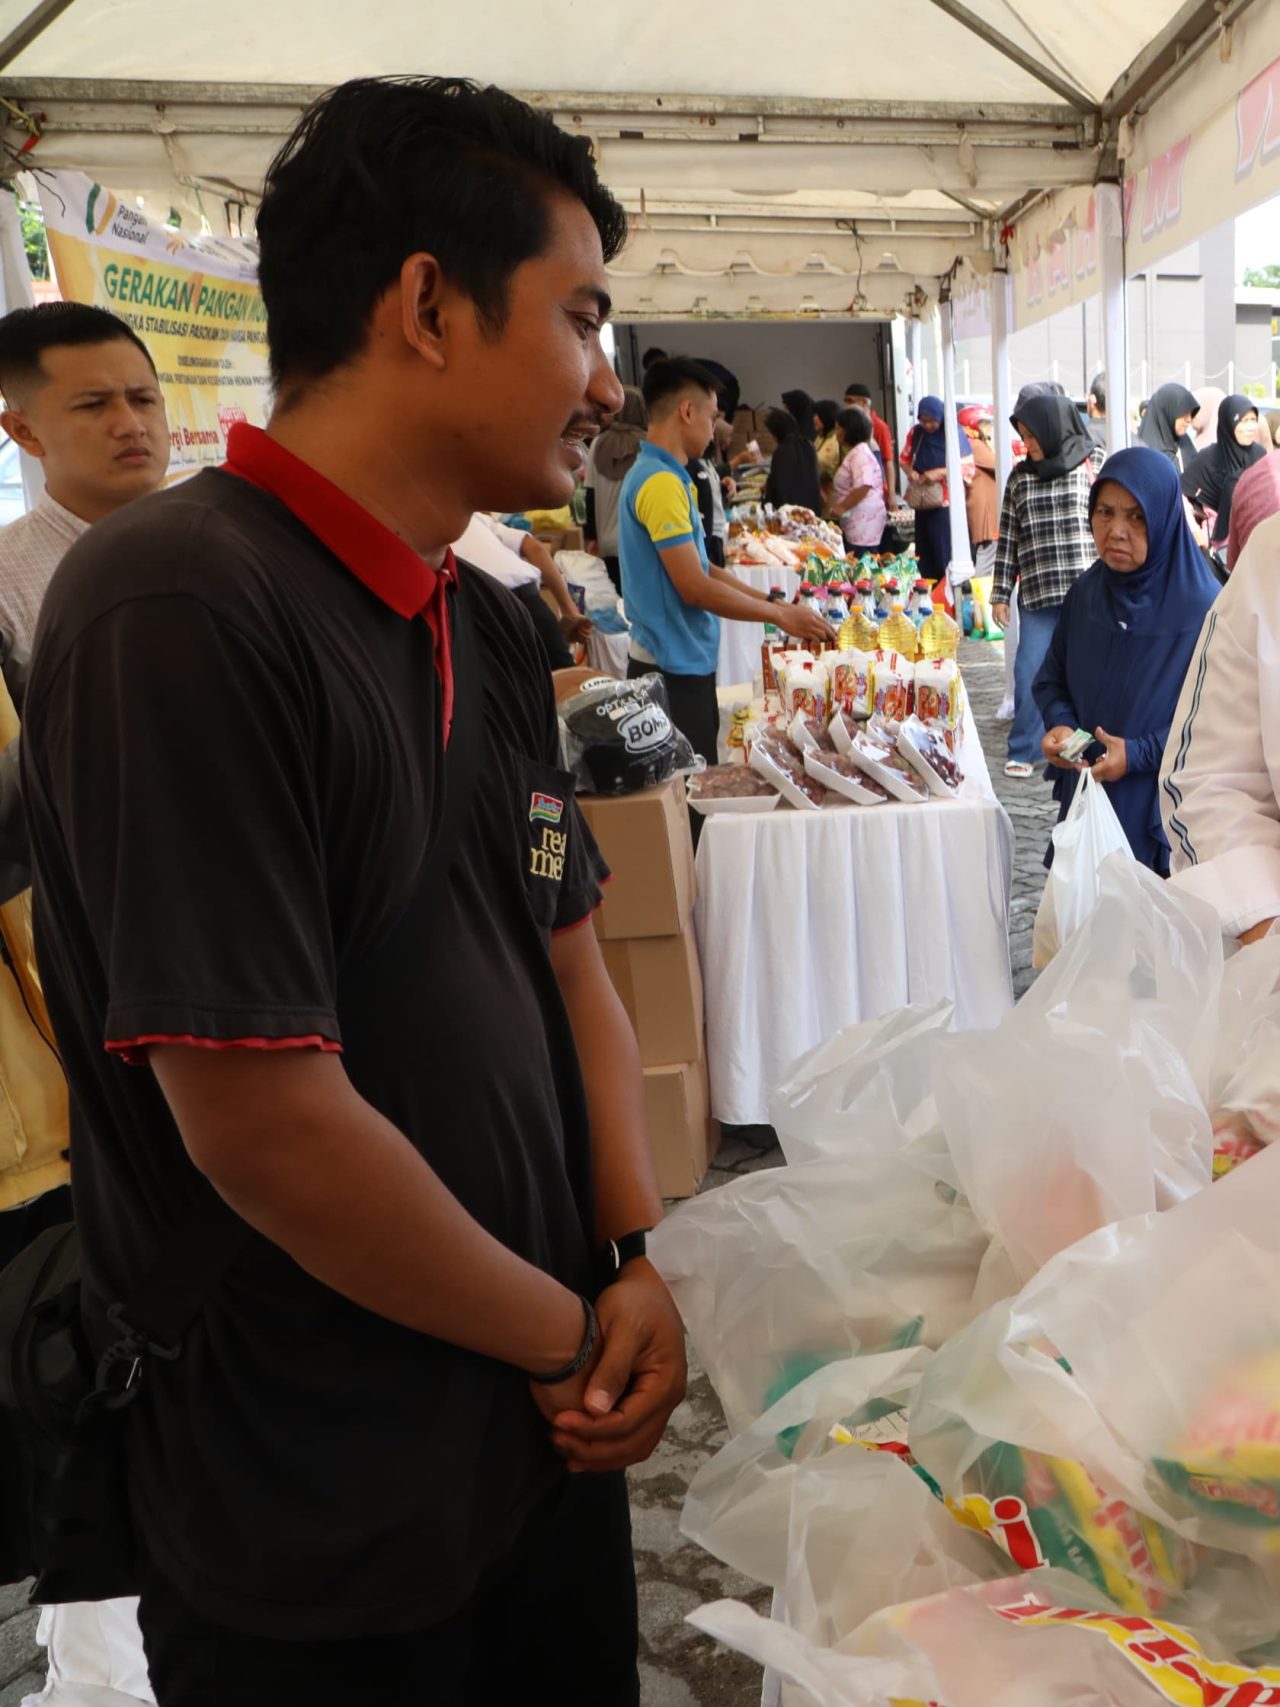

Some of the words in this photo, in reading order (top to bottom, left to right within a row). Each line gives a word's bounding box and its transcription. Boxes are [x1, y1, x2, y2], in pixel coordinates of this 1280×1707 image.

[117, 205, 148, 227] Pangan
[111, 221, 150, 245] Nasional
[104, 263, 194, 313] GERAKAN
[195, 285, 250, 321] PANGAN
[145, 316, 189, 337] STABILISASI
[183, 427, 220, 446] Bersama
